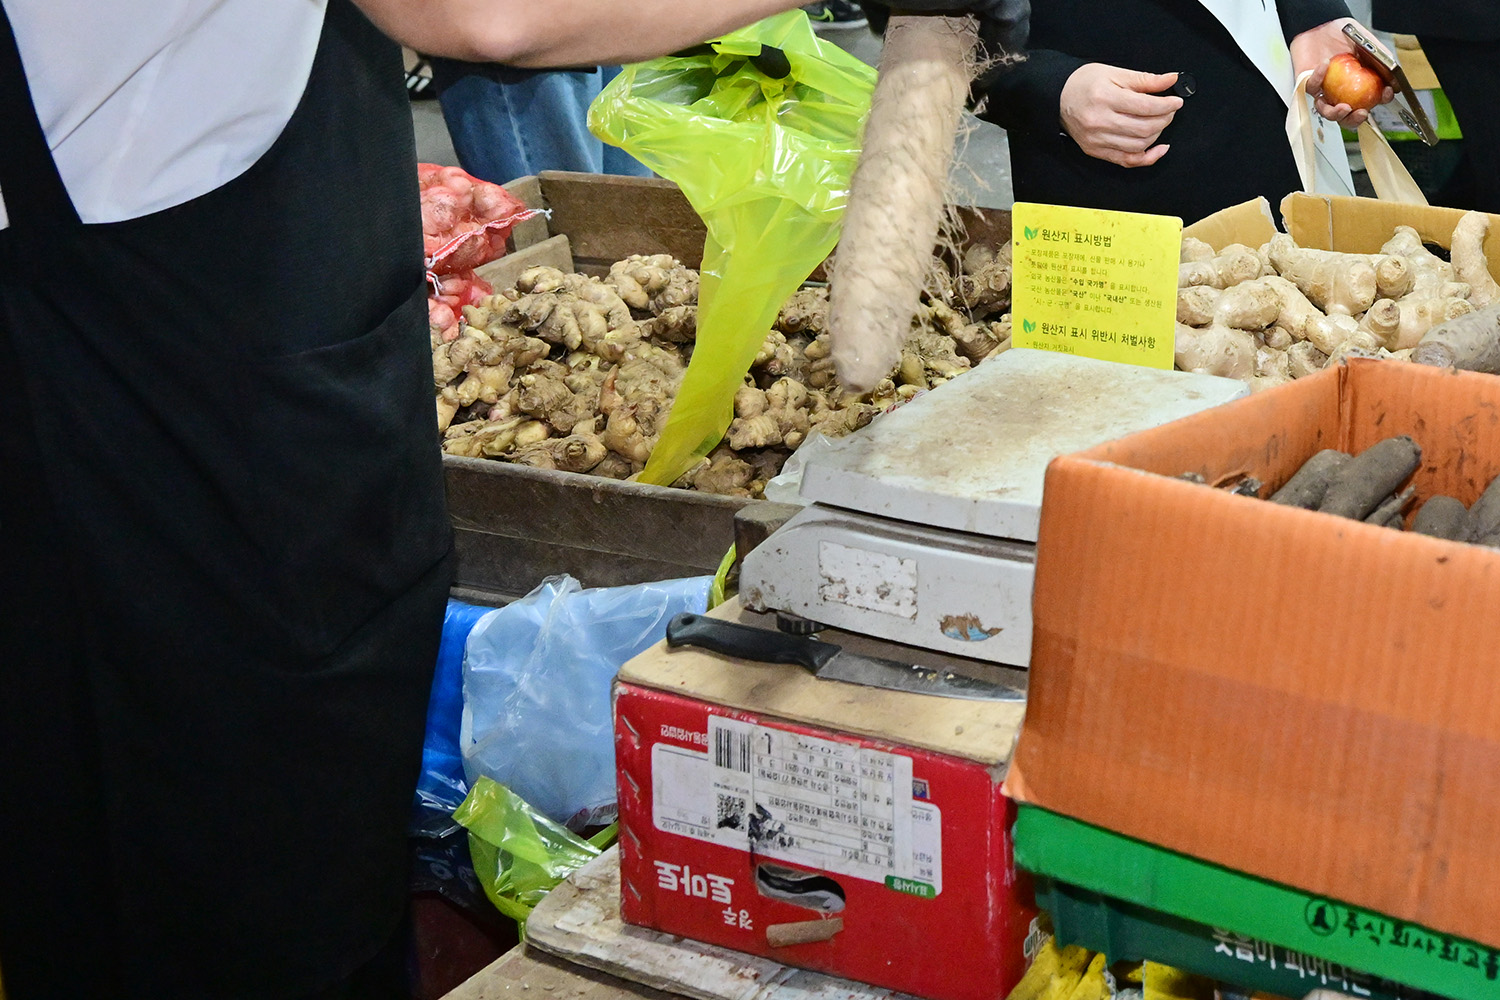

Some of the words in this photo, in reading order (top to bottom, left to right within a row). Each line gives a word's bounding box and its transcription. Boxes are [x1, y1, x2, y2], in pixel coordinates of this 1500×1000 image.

[1042, 228, 1071, 243] 원산지
[1074, 232, 1113, 248] 표시방법
[1051, 263, 1068, 272] 원산지
[1071, 266, 1088, 275] 표시를
[1045, 275, 1067, 285] 농산물은
[1031, 285, 1042, 294] 국산
[1045, 287, 1067, 297] 농산물은
[1144, 299, 1162, 309] 생산된
[1033, 341, 1050, 350] 원산지
[1041, 322, 1067, 336] 원산지
[1070, 326, 1088, 340] 표시
[1091, 329, 1117, 344] 위반시
[1121, 332, 1156, 350] 처벌사항
[653, 859, 735, 905] 토마토
[892, 877, 929, 897] 표시사항
[721, 906, 754, 931] 경주
